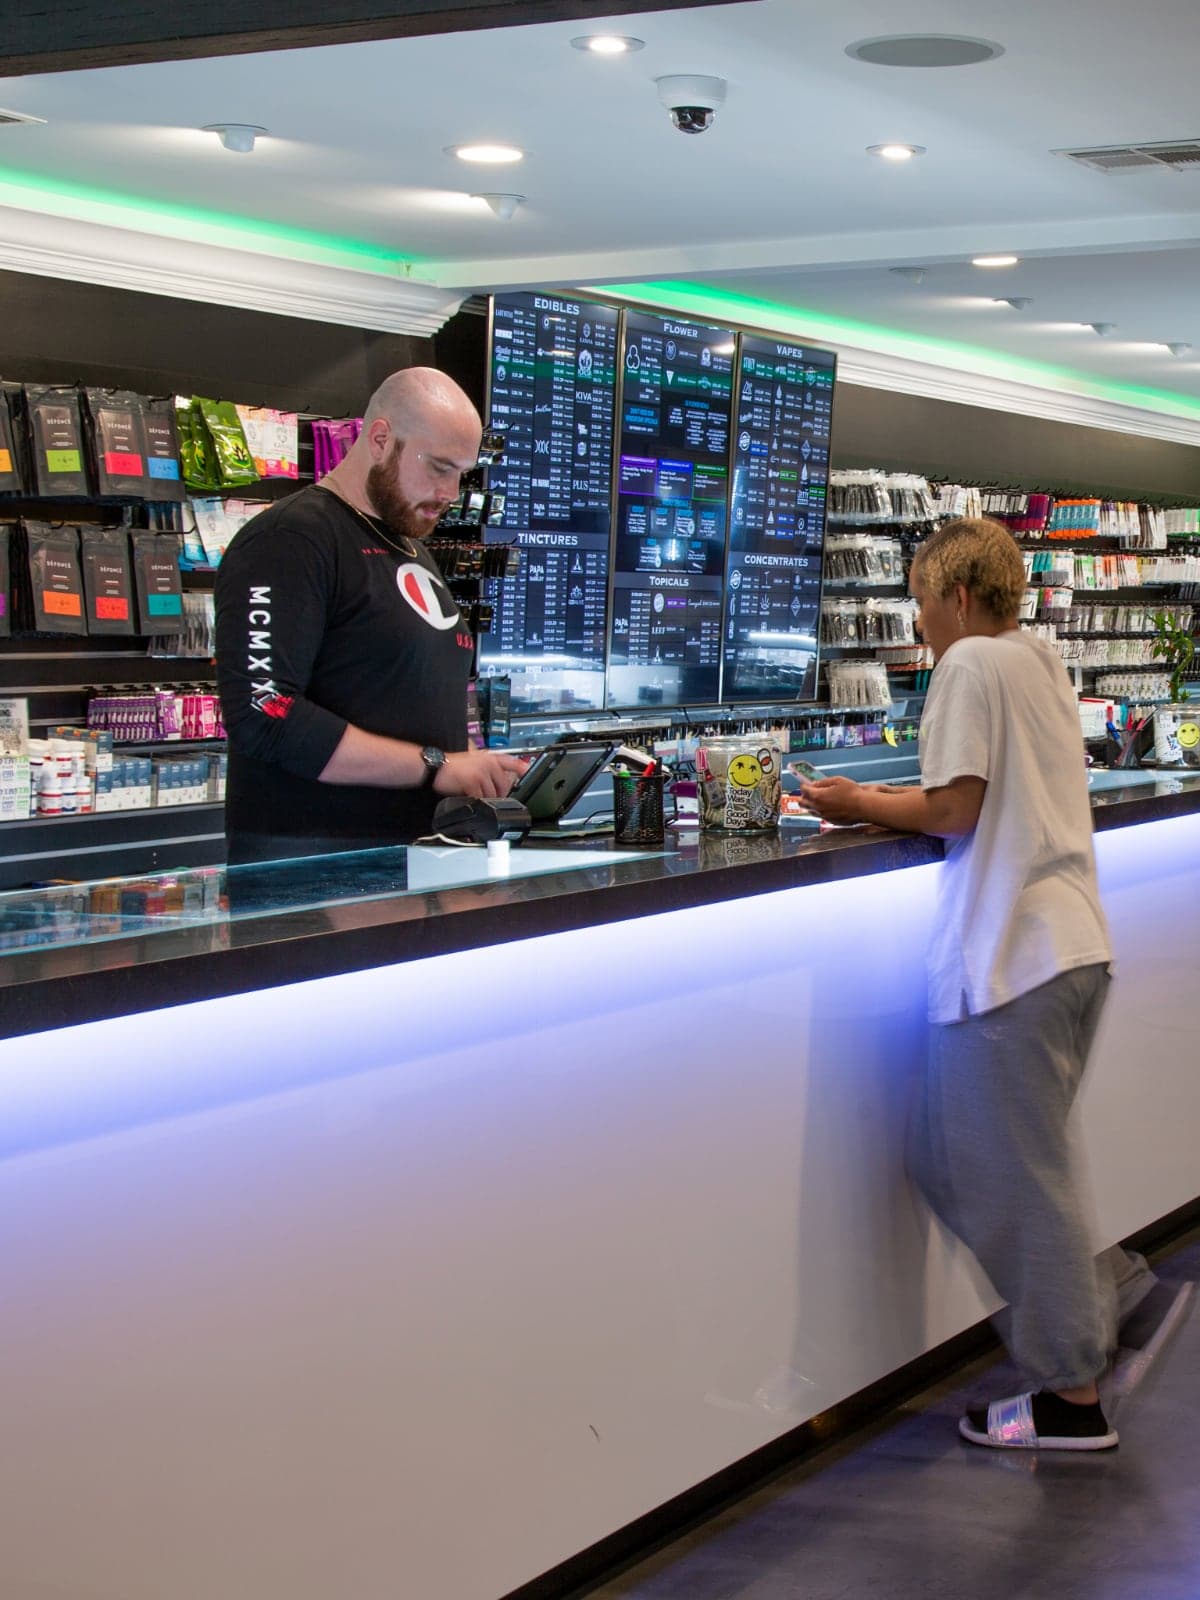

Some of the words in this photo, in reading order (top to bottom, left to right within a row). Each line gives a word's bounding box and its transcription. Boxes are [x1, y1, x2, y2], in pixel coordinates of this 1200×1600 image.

[534, 297, 580, 316] EDIBLES
[663, 322, 698, 338] FLOWER
[776, 344, 803, 359] VAPES
[517, 533, 579, 546] TINCTURES
[744, 555, 809, 567] CONCENTRATES
[649, 576, 690, 587] TOPICALS
[728, 787, 752, 797] Today
